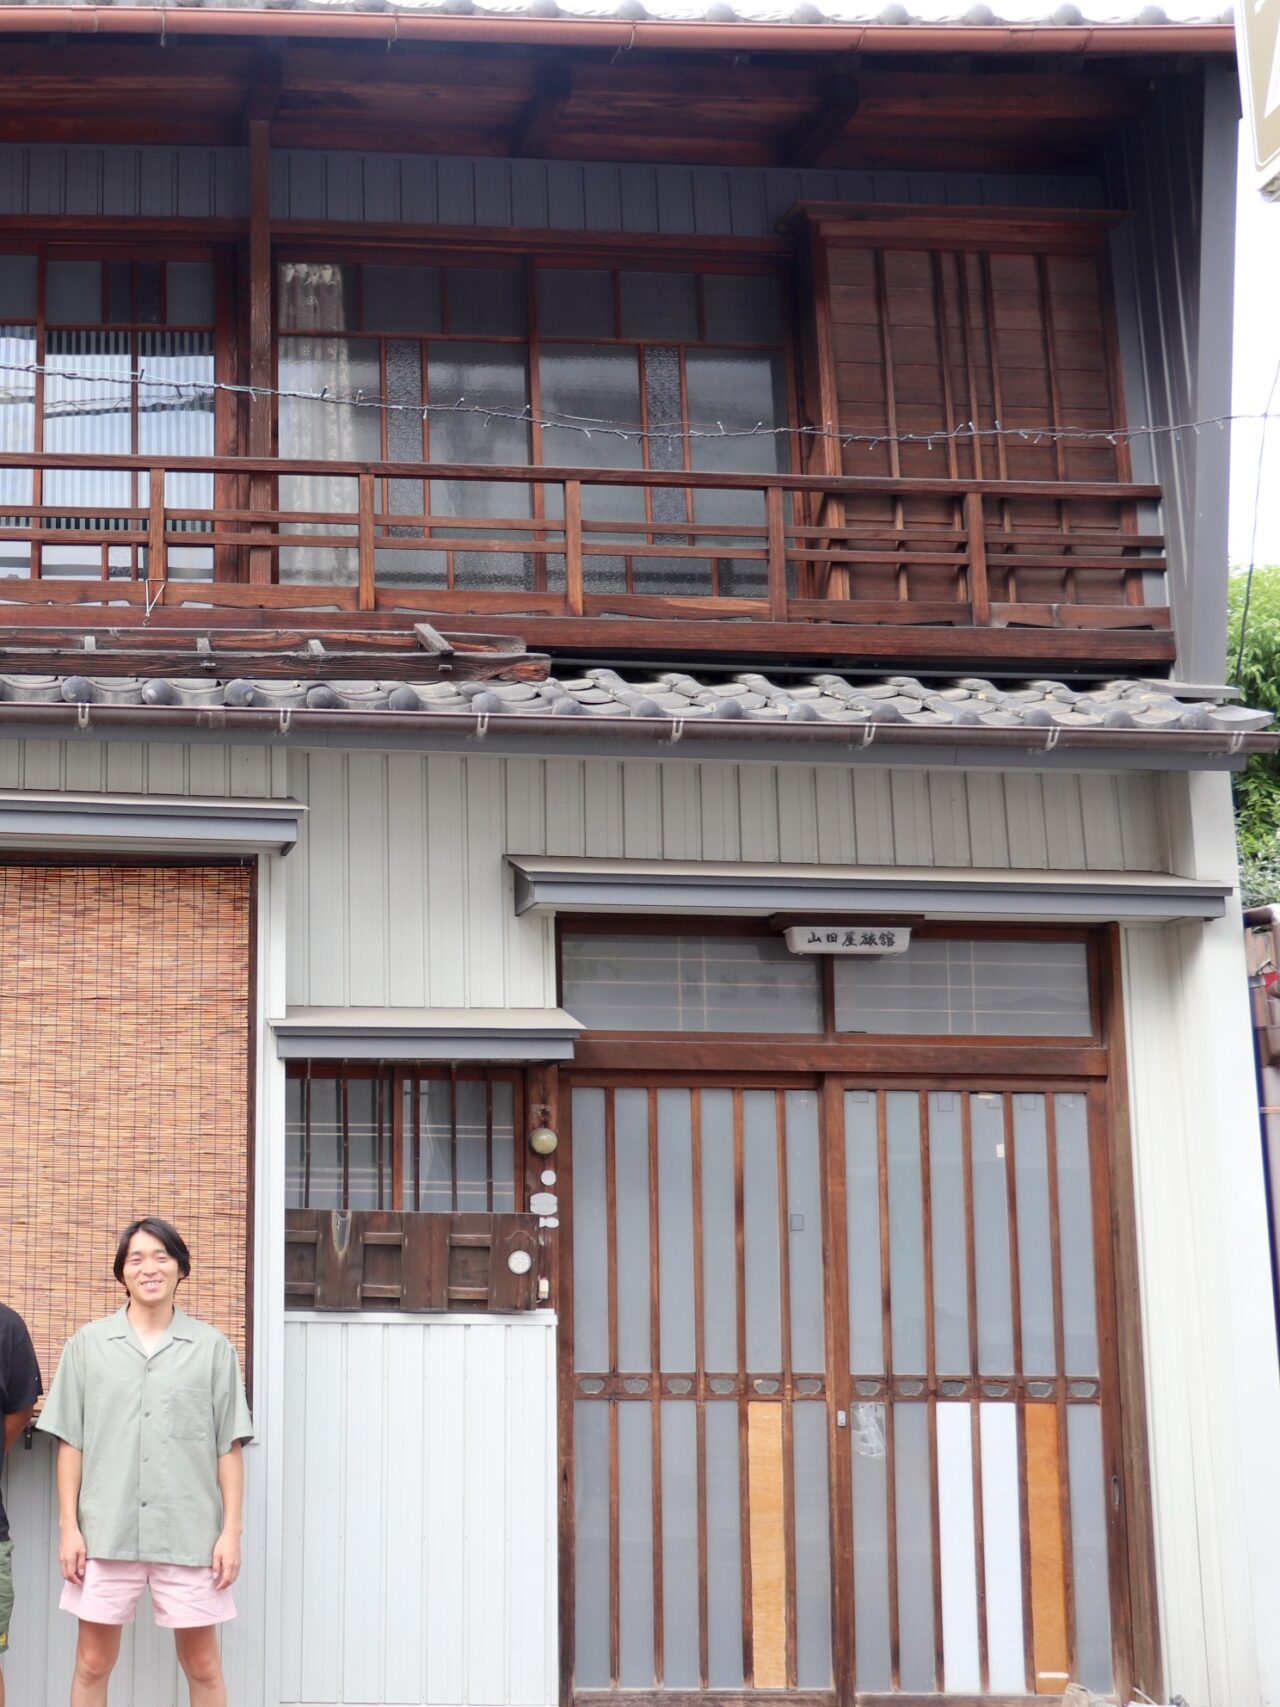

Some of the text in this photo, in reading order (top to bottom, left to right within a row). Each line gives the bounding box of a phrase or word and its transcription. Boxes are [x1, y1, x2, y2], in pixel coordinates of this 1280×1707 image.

[807, 931, 896, 947] 山田屋旅館
